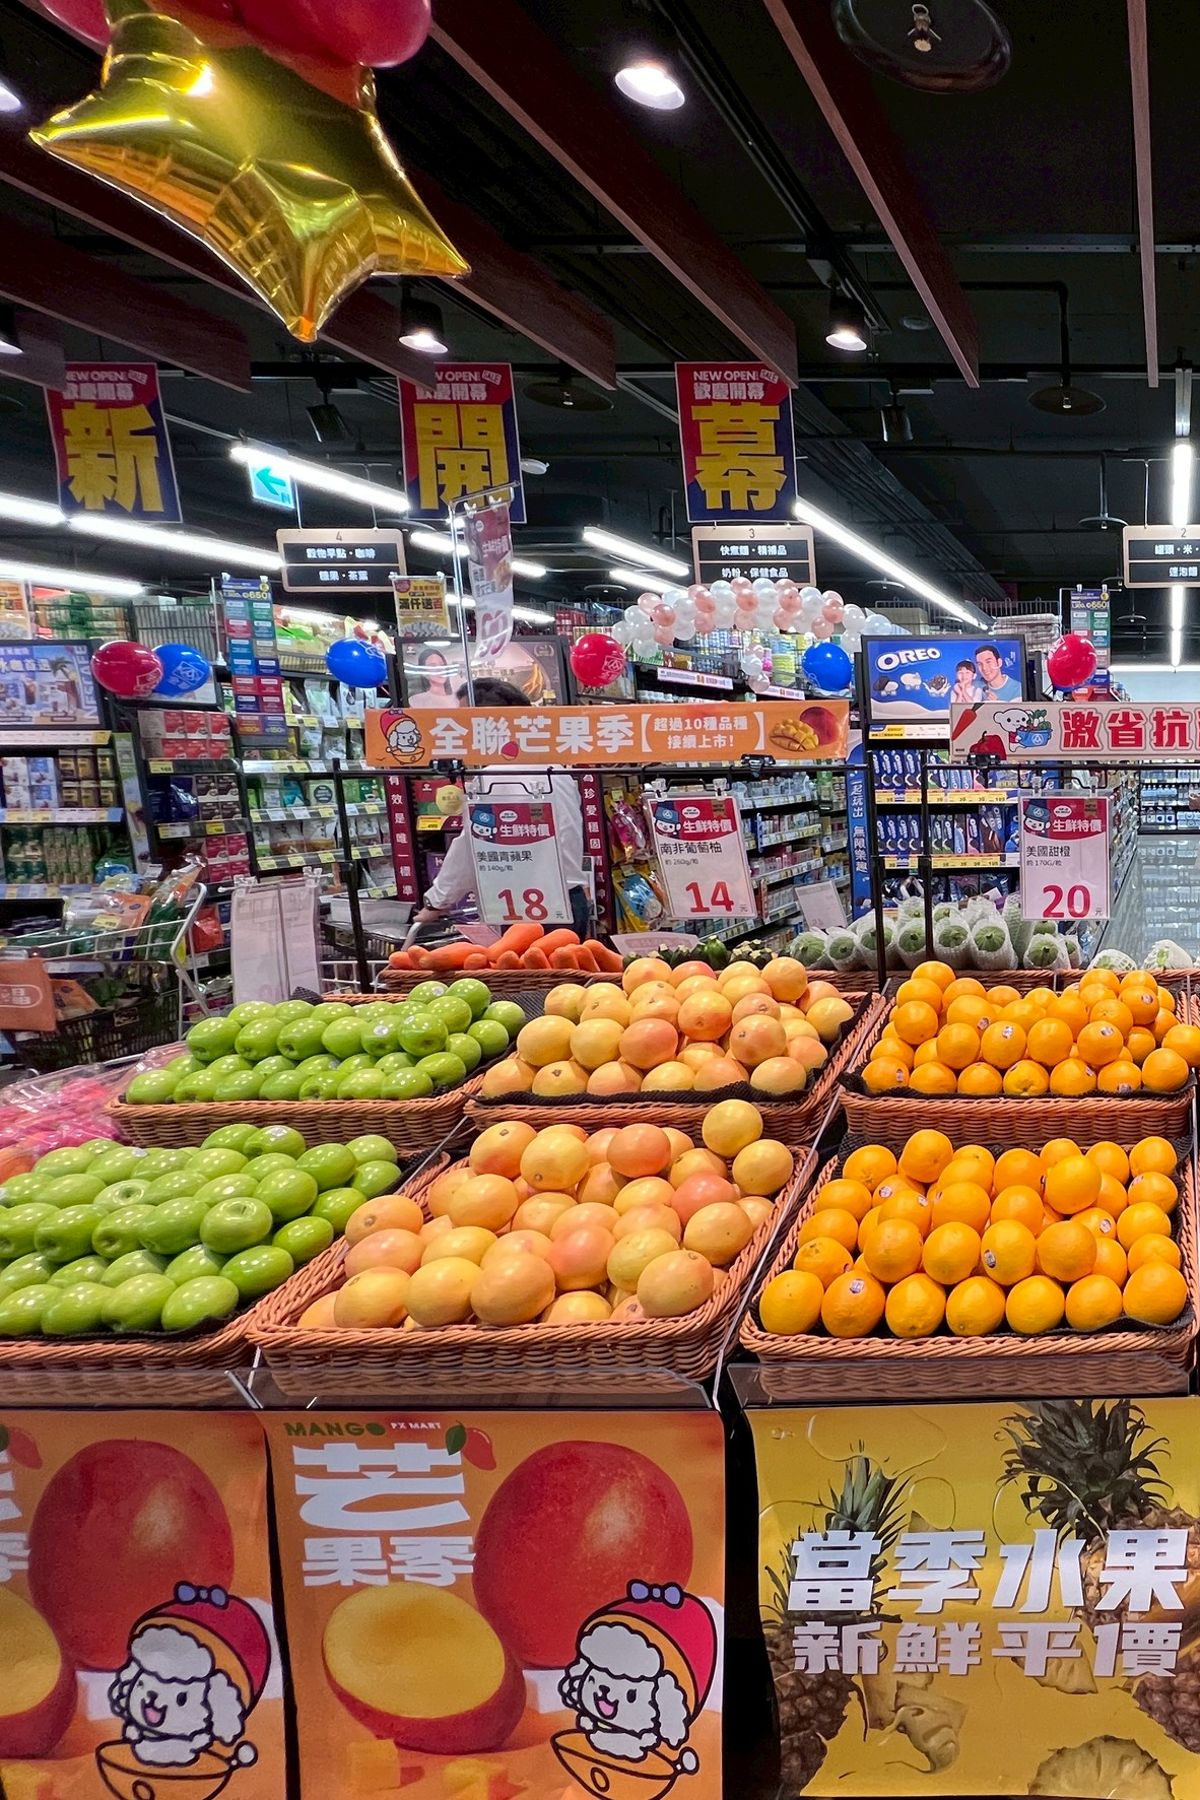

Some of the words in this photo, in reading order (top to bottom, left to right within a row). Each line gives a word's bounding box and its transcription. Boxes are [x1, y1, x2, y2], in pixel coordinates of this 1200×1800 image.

[694, 371, 722, 381] NEW
[61, 402, 165, 512] 新
[414, 404, 511, 510] 開
[692, 402, 787, 511] 幕
[335, 531, 343, 541] 4
[748, 529, 755, 539] 3
[1180, 527, 1187, 538] 2
[876, 647, 941, 671] OREO
[429, 714, 635, 756] 全聯芒果季
[500, 823, 551, 838] 生鮮特價
[683, 818, 733, 833] 生鮮特價
[1052, 819, 1102, 832] 生鮮特價
[660, 841, 723, 855] 南非葡萄柚
[1026, 845, 1071, 858] 美國甜橙
[497, 888, 549, 921] 18
[686, 881, 735, 914] 14
[1042, 884, 1091, 919] 20
[284, 1422, 386, 1437] MANGO
[391, 1422, 407, 1431] PX
[409, 1422, 442, 1431] MART
[292, 1442, 471, 1531] 芒
[302, 1535, 477, 1587] 果季
[787, 1528, 1189, 1614] 當季水果
[791, 1620, 1184, 1678] 新鮮平價
